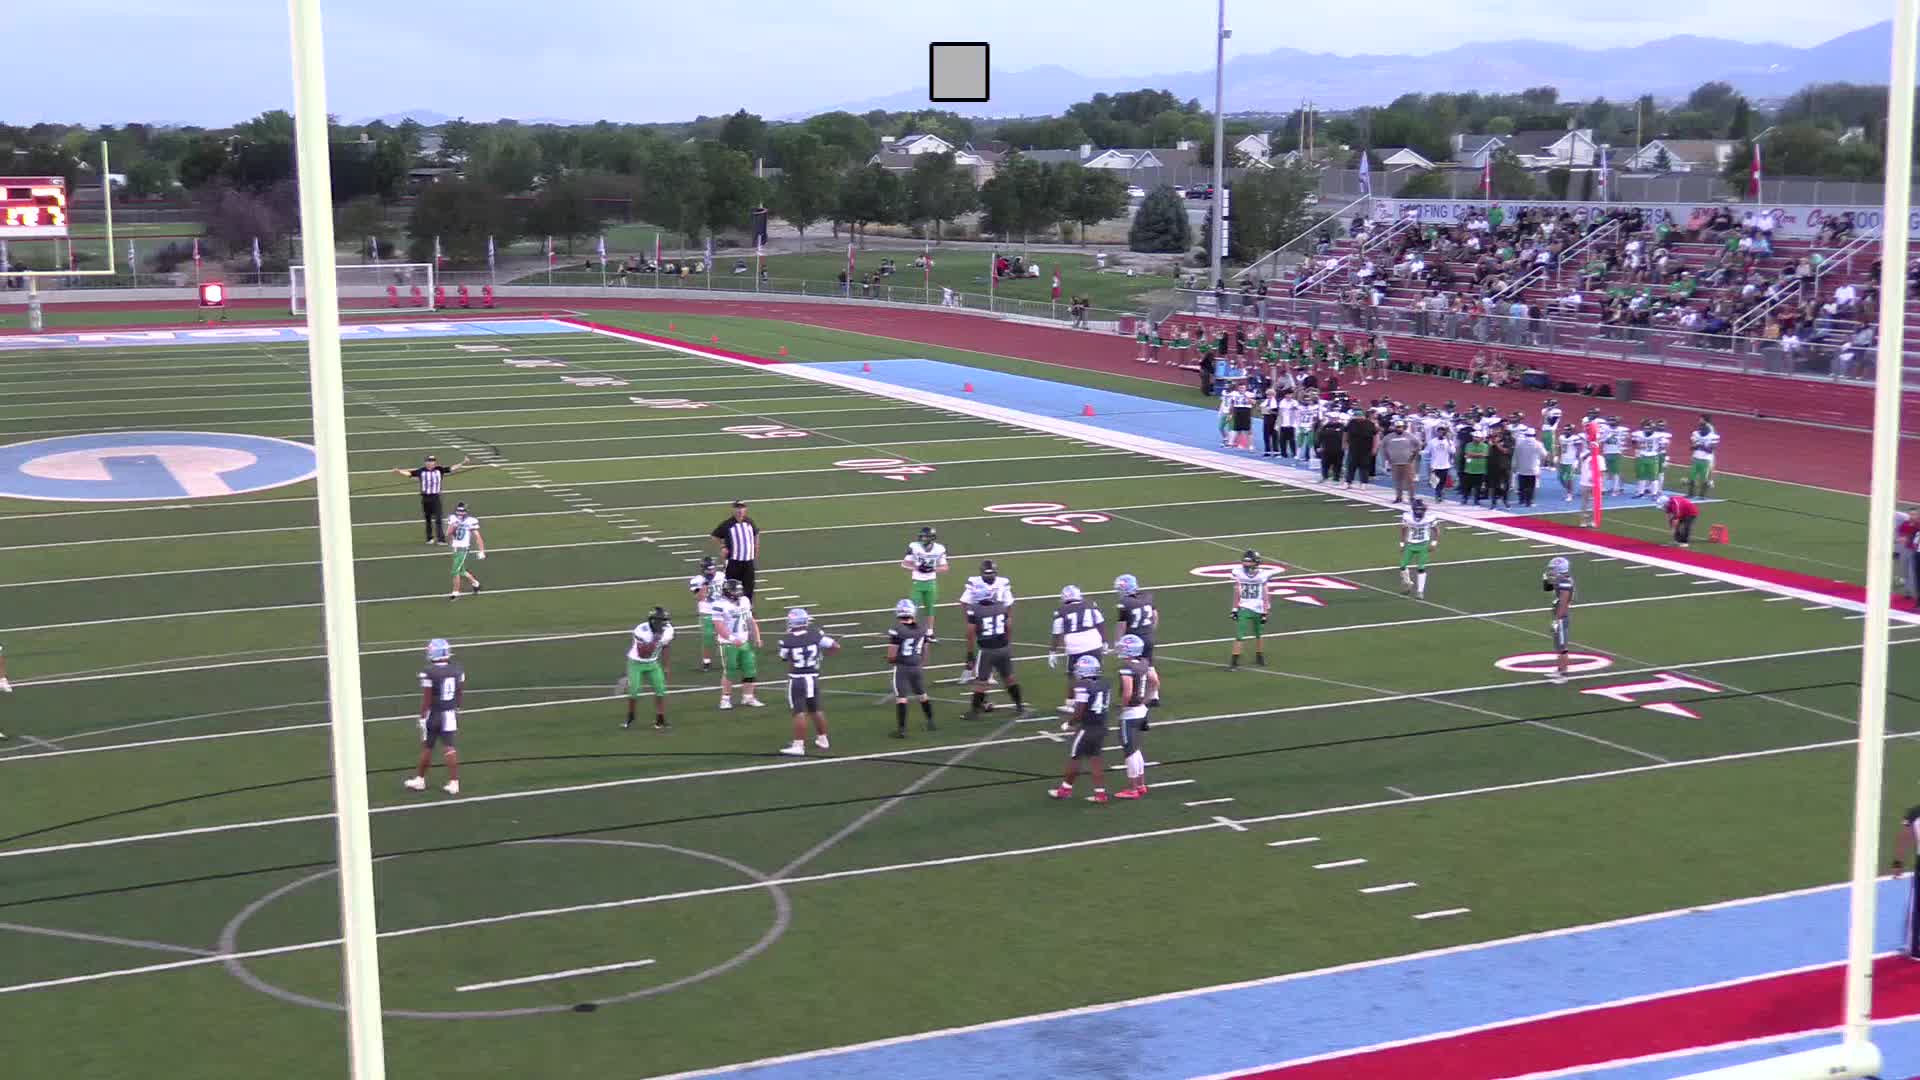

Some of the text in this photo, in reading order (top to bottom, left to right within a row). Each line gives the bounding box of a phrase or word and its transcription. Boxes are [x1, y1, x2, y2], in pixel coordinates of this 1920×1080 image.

[720, 425, 809, 439] 50
[982, 502, 1113, 525] 30
[1066, 608, 1094, 633] 74
[792, 643, 818, 669] 52
